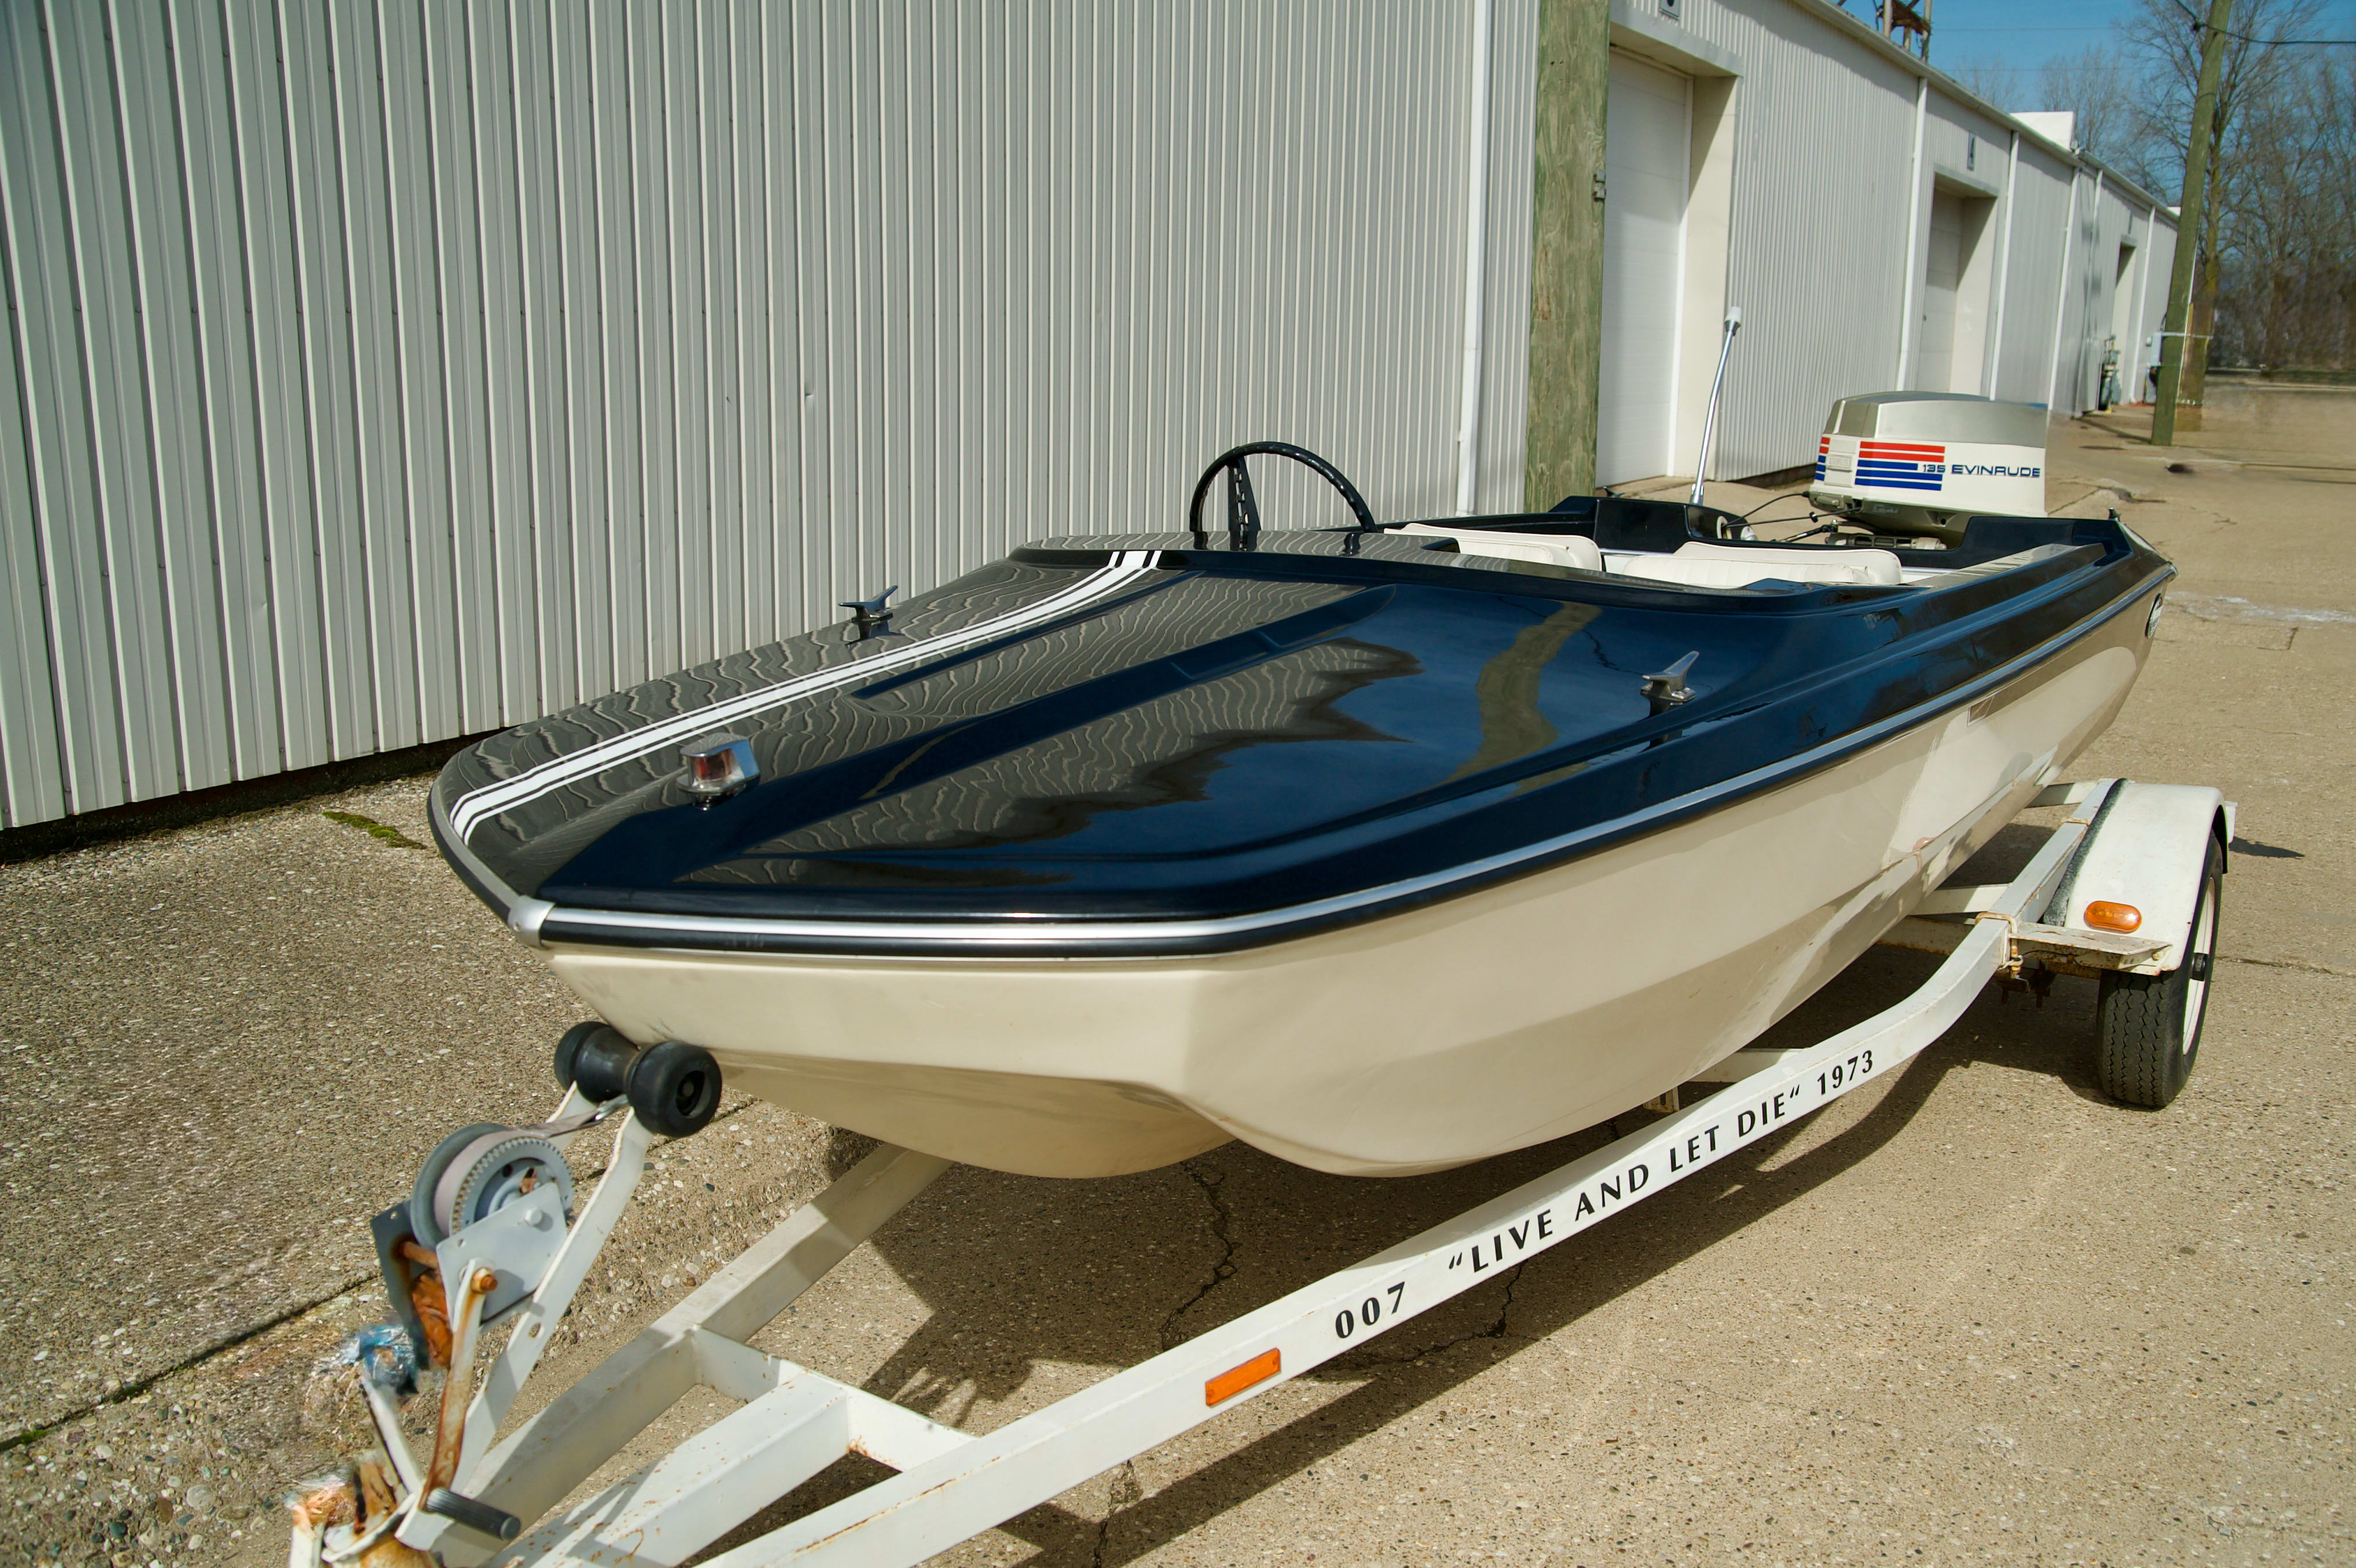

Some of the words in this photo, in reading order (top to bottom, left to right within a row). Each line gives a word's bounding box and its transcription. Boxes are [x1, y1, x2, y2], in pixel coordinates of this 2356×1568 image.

[1922, 464, 1946, 473] 135
[1951, 464, 2041, 478] EVINRUDE
[1335, 1281, 1405, 1339] 007
[1448, 1208, 1553, 1273] “LIVE
[1574, 1164, 1649, 1222] AND
[1669, 1125, 1720, 1173] LET
[1816, 1049, 1873, 1096] 1973
